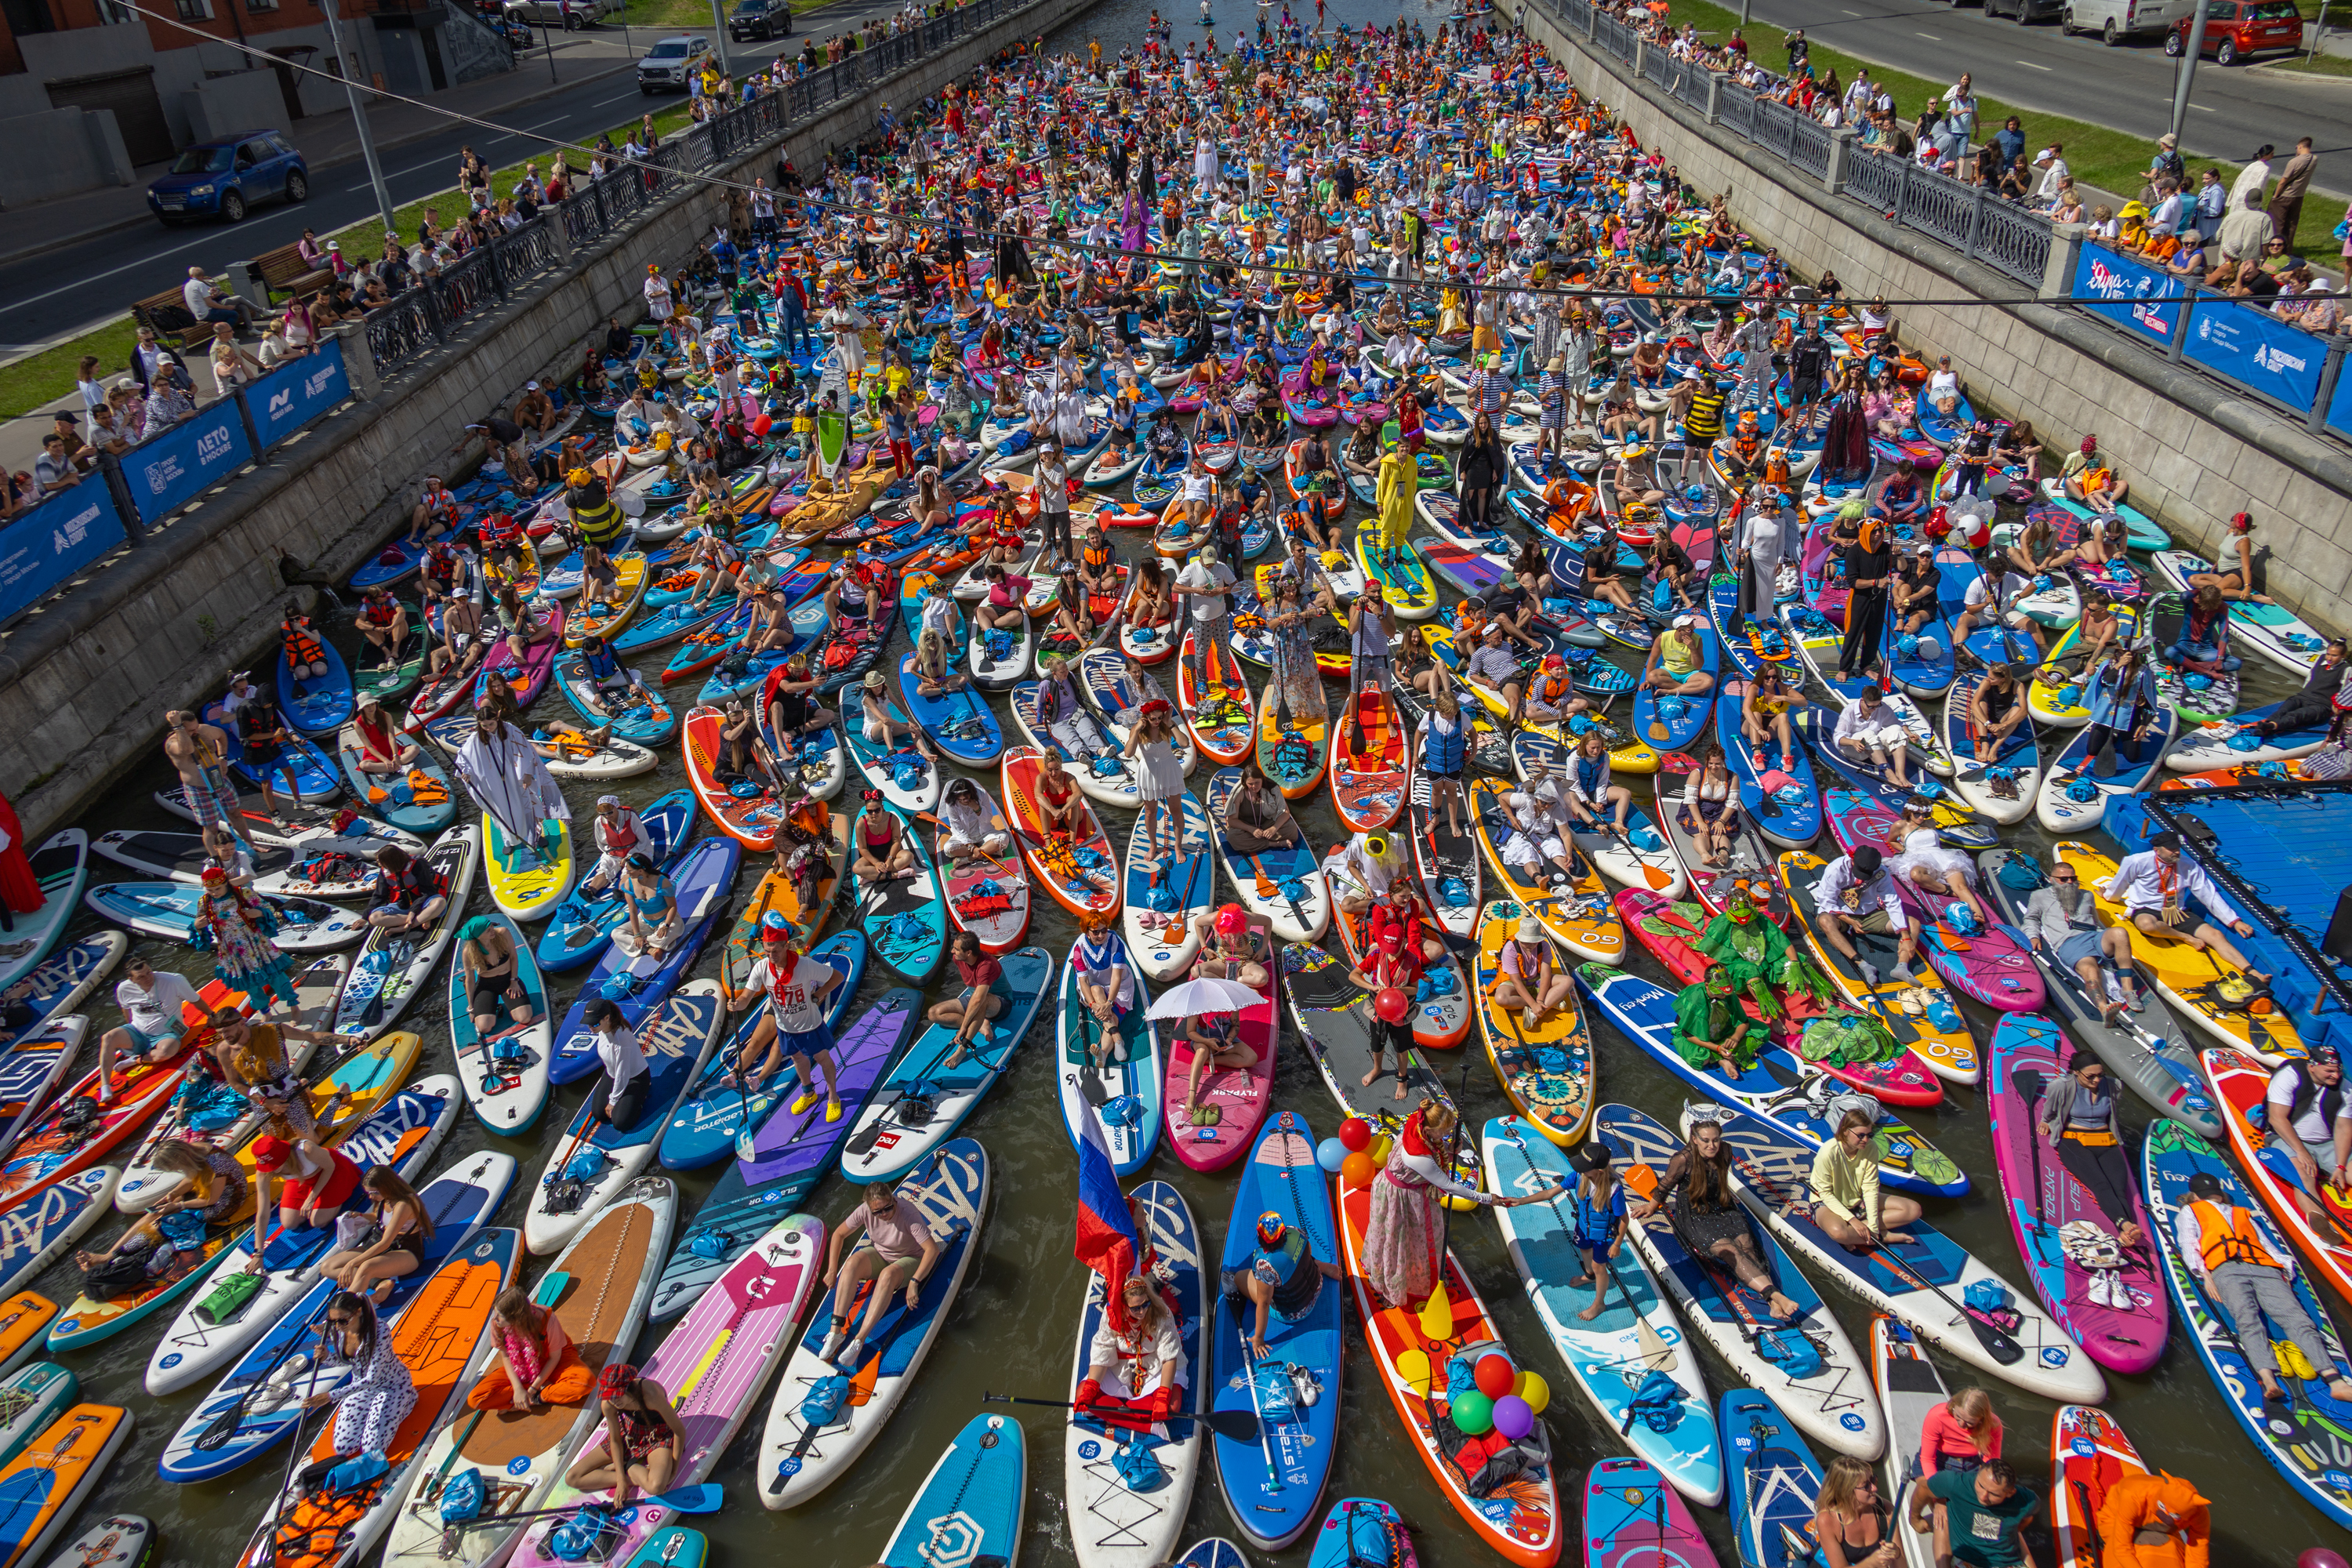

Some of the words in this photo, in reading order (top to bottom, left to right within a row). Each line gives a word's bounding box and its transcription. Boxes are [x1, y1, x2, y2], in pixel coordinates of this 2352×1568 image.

[2132, 303, 2147, 321] САП
[2267, 358, 2285, 375] СПОРТ
[2270, 347, 2307, 372] МОСКОВСКИЙ
[311, 363, 336, 385] МОСКОВСКИЙ
[314, 379, 327, 394] СПОРТ
[197, 425, 230, 456] ЛЕТО
[200, 456, 207, 466] В
[205, 441, 233, 463] МОСКВЕ
[161, 455, 178, 469] ПРОЕКТ
[163, 464, 177, 475] МЭРА
[165, 467, 185, 482] МОСКВЫ
[63, 503, 101, 535] МОСКОВСКИЙ
[67, 526, 88, 546] СПОРТ
[1580, 932, 1621, 945] GQ
[1619, 989, 1665, 1011] Monkey
[1927, 1042, 1973, 1061] GQ
[879, 1135, 897, 1147] red
[764, 1192, 778, 1201] 139
[2044, 1165, 2057, 1219] PATROL
[2070, 1178, 2081, 1212] SUP
[1775, 1228, 1820, 1264] ATLAS
[1826, 1263, 1897, 1318] TOURING
[1896, 1270, 1922, 1288] 10.6
[1733, 1300, 1752, 1320] 10.8
[2046, 1349, 2061, 1361] 646
[1843, 1416, 1860, 1426] 861
[1085, 1443, 1098, 1456] 524
[1736, 1437, 1751, 1446] 468
[2076, 1444, 2093, 1454] 180
[514, 1459, 525, 1470] 73
[782, 1463, 798, 1472] 737
[1485, 1503, 1504, 1515] 1989
